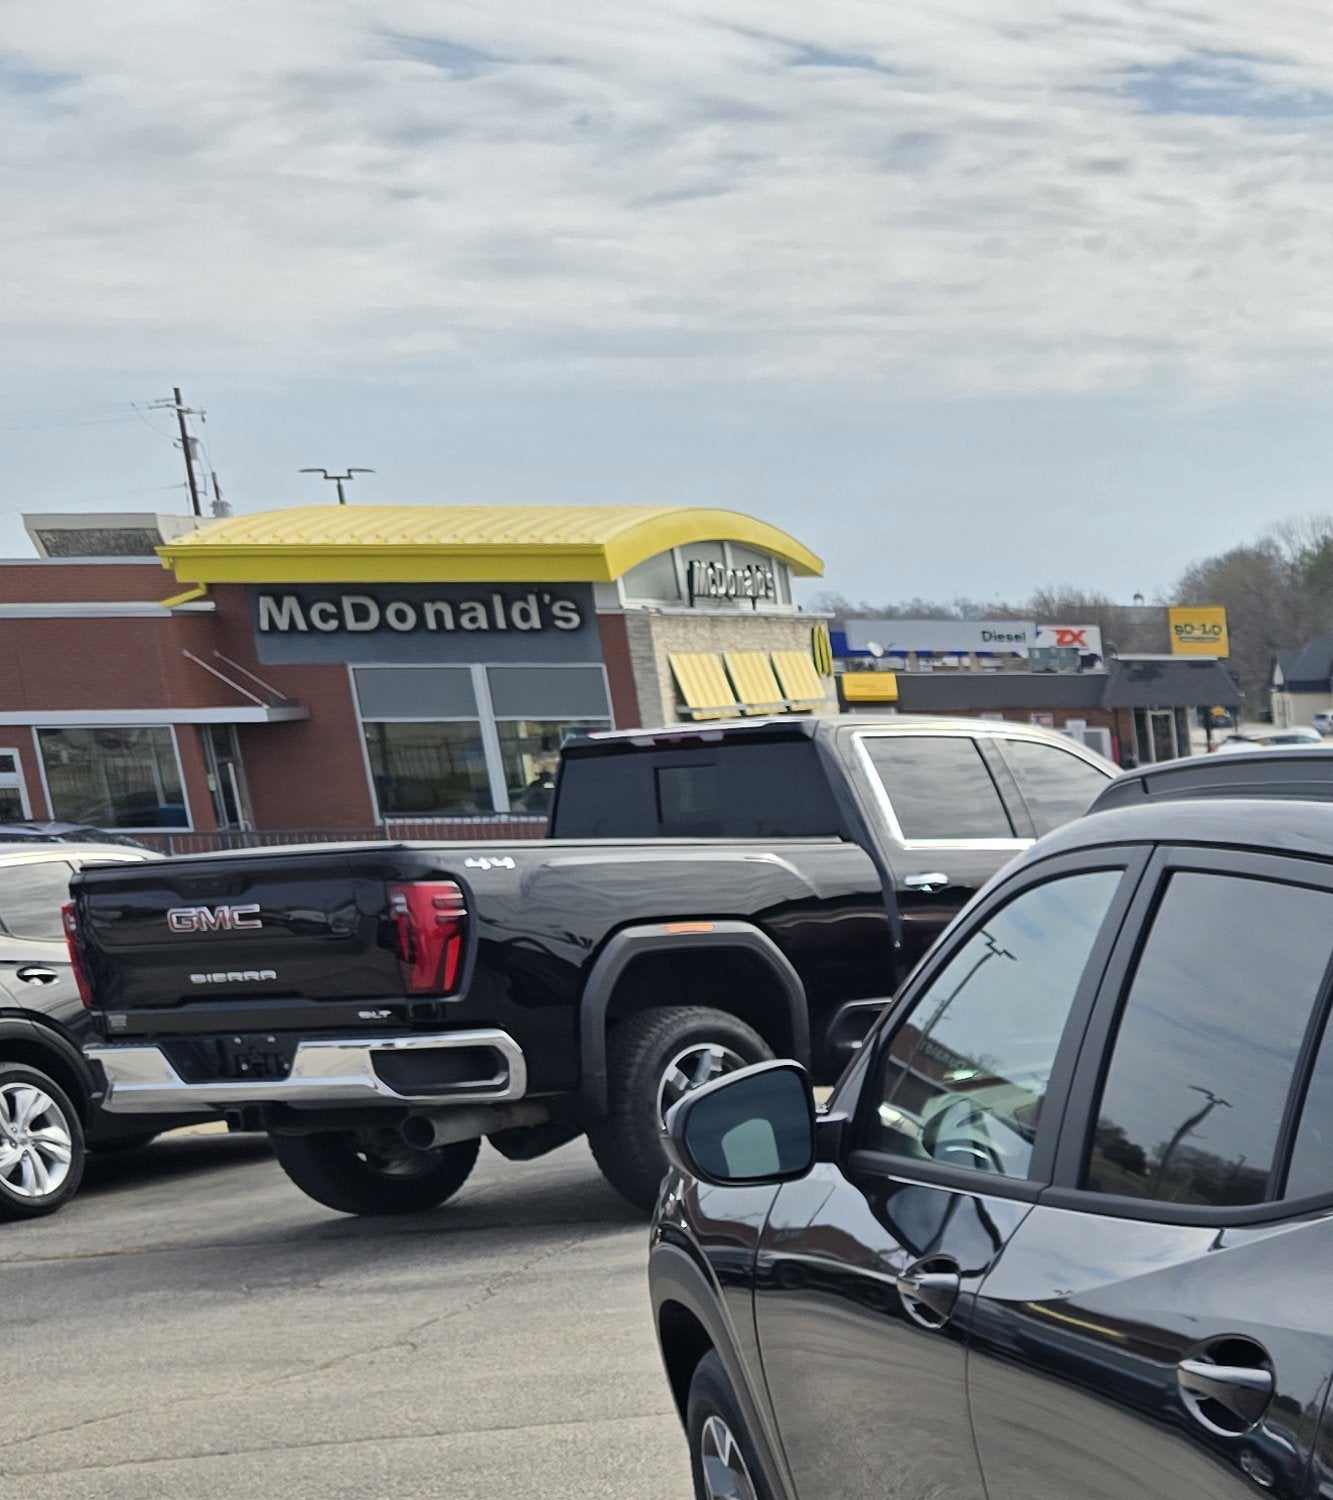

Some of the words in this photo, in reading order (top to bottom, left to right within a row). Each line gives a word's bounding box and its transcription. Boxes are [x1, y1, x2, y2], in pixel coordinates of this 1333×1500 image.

[258, 592, 582, 633] McDonald's
[982, 629, 1027, 644] Diesel
[166, 903, 263, 933] GMC
[189, 969, 277, 984] SIERRA
